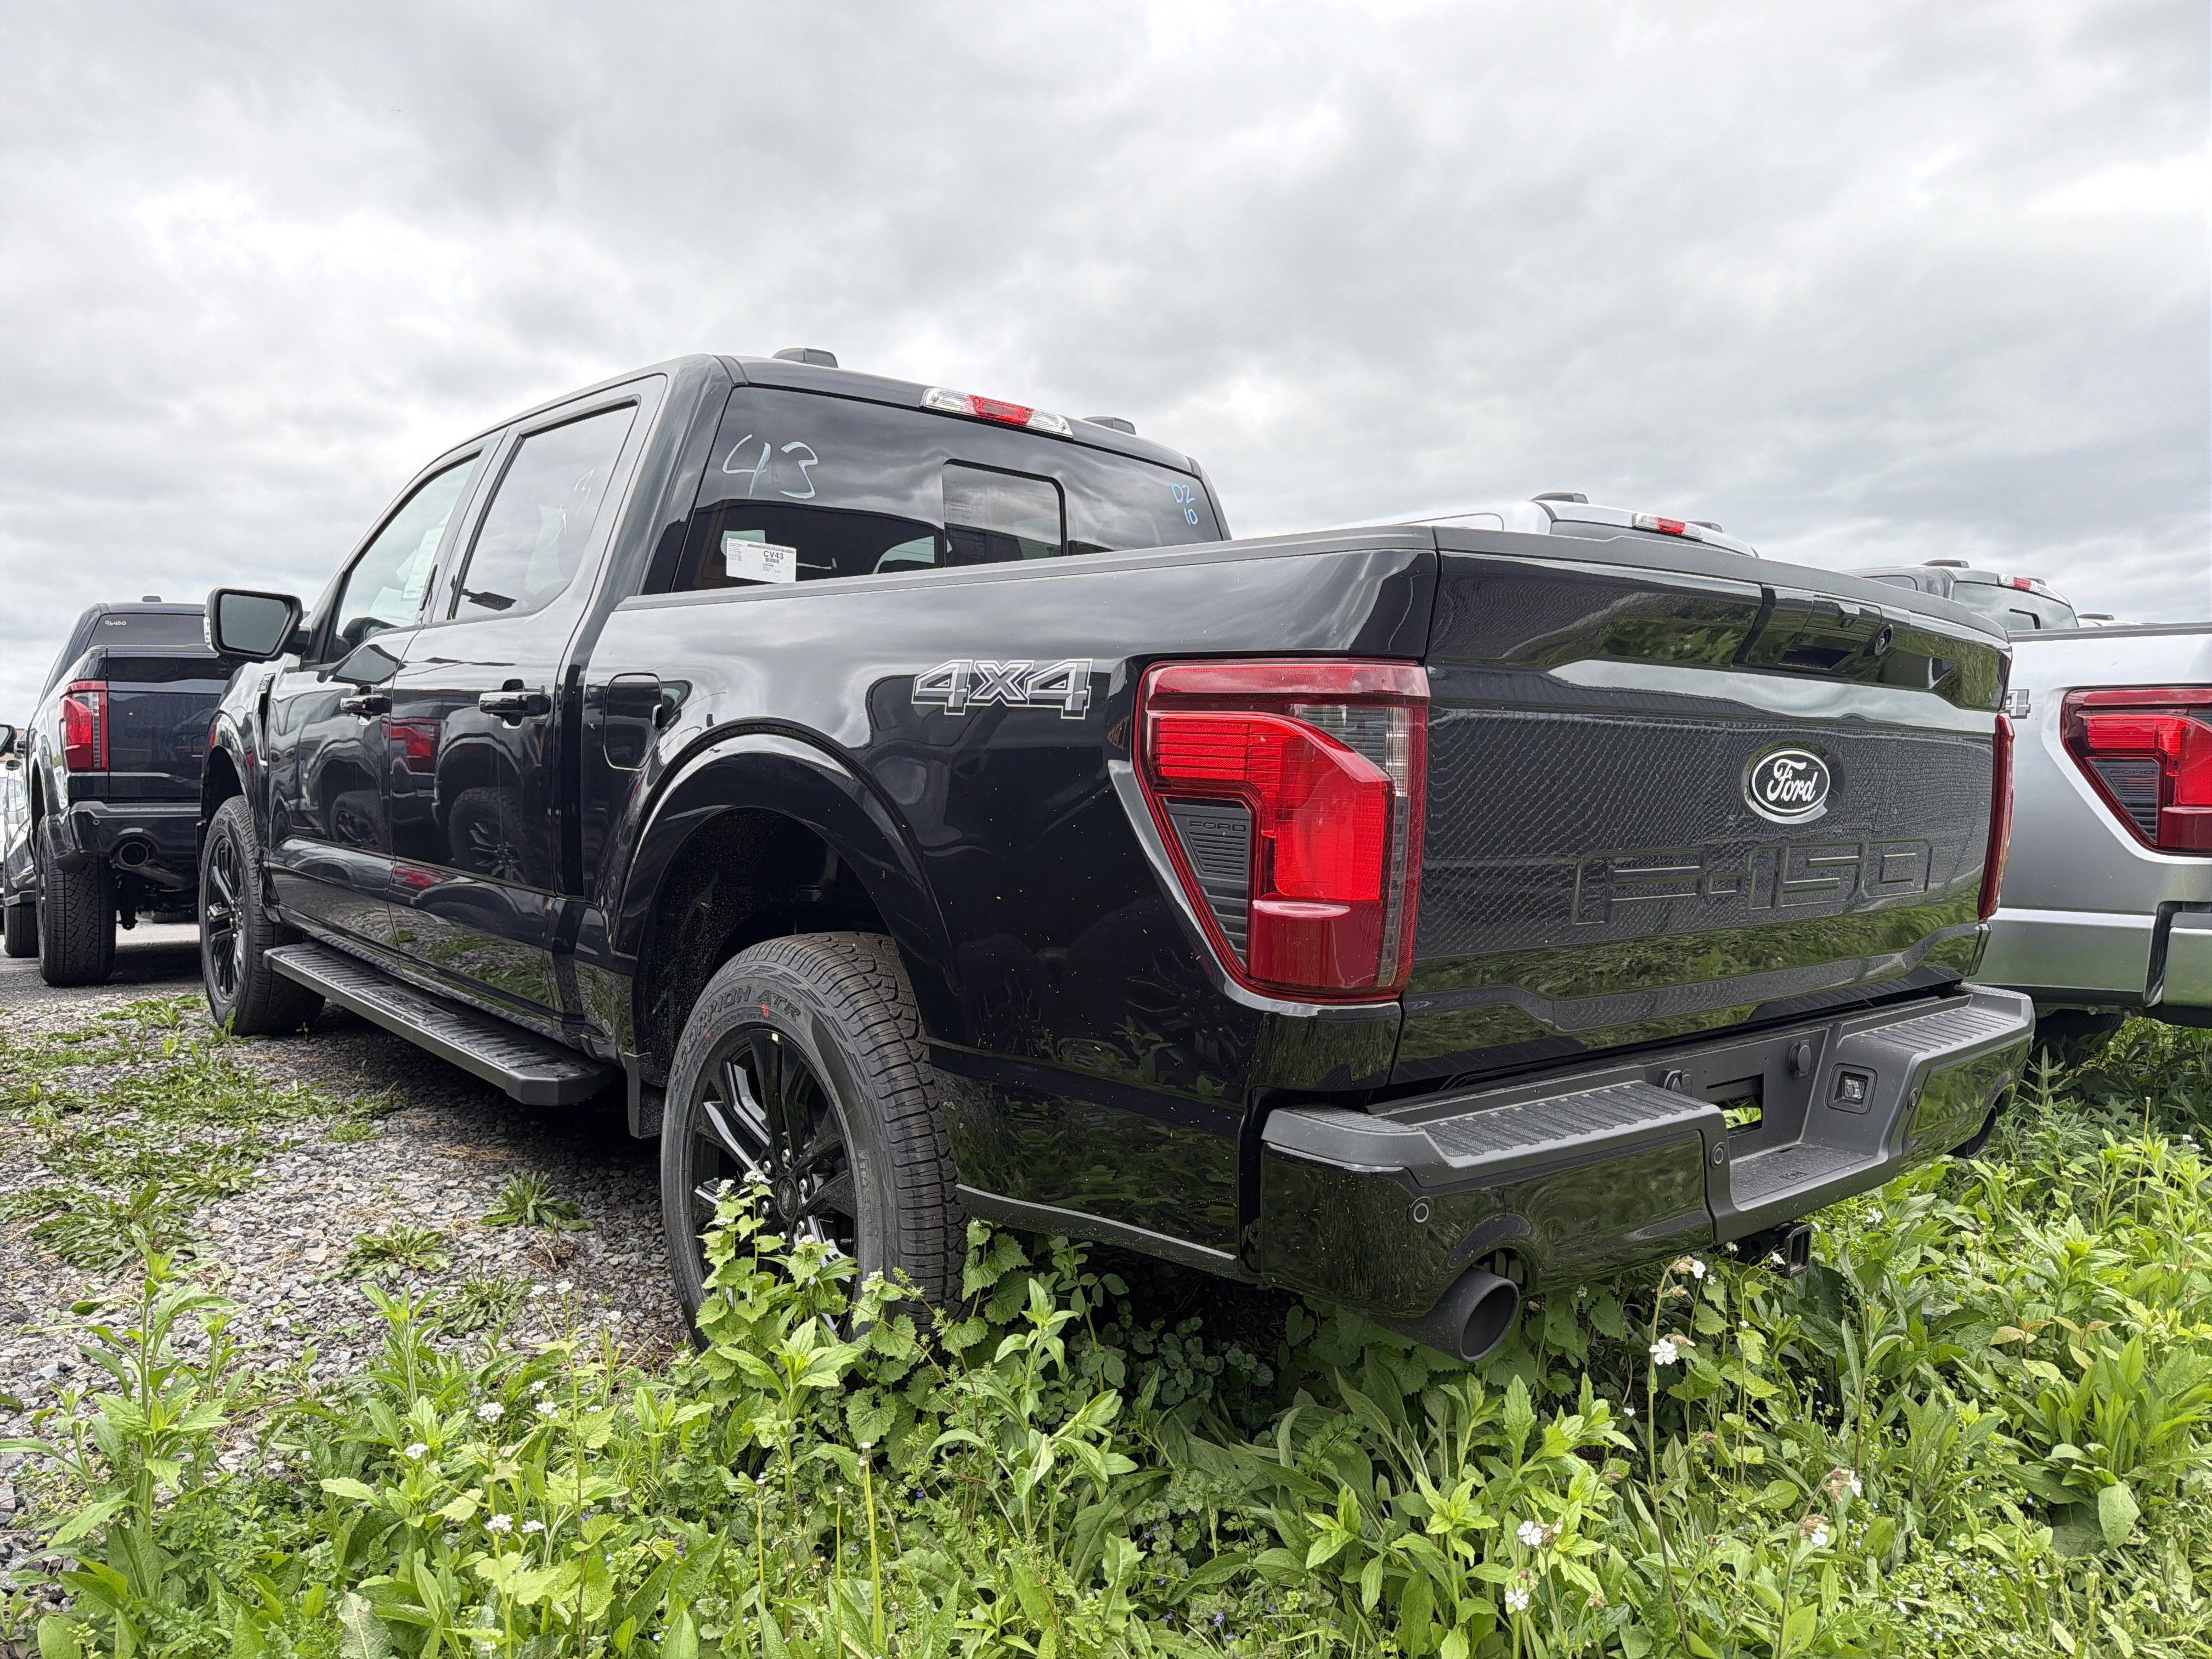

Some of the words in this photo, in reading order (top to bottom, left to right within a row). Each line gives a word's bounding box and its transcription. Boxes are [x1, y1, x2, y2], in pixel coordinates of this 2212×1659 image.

[722, 434, 819, 499] 43
[1183, 508, 1198, 526] 10
[763, 550, 784, 560] CV43
[1767, 759, 1818, 802] Ford
[1189, 821, 1246, 832] FORD
[672, 985, 752, 1092] SCORPION
[757, 988, 802, 1022] ATR
